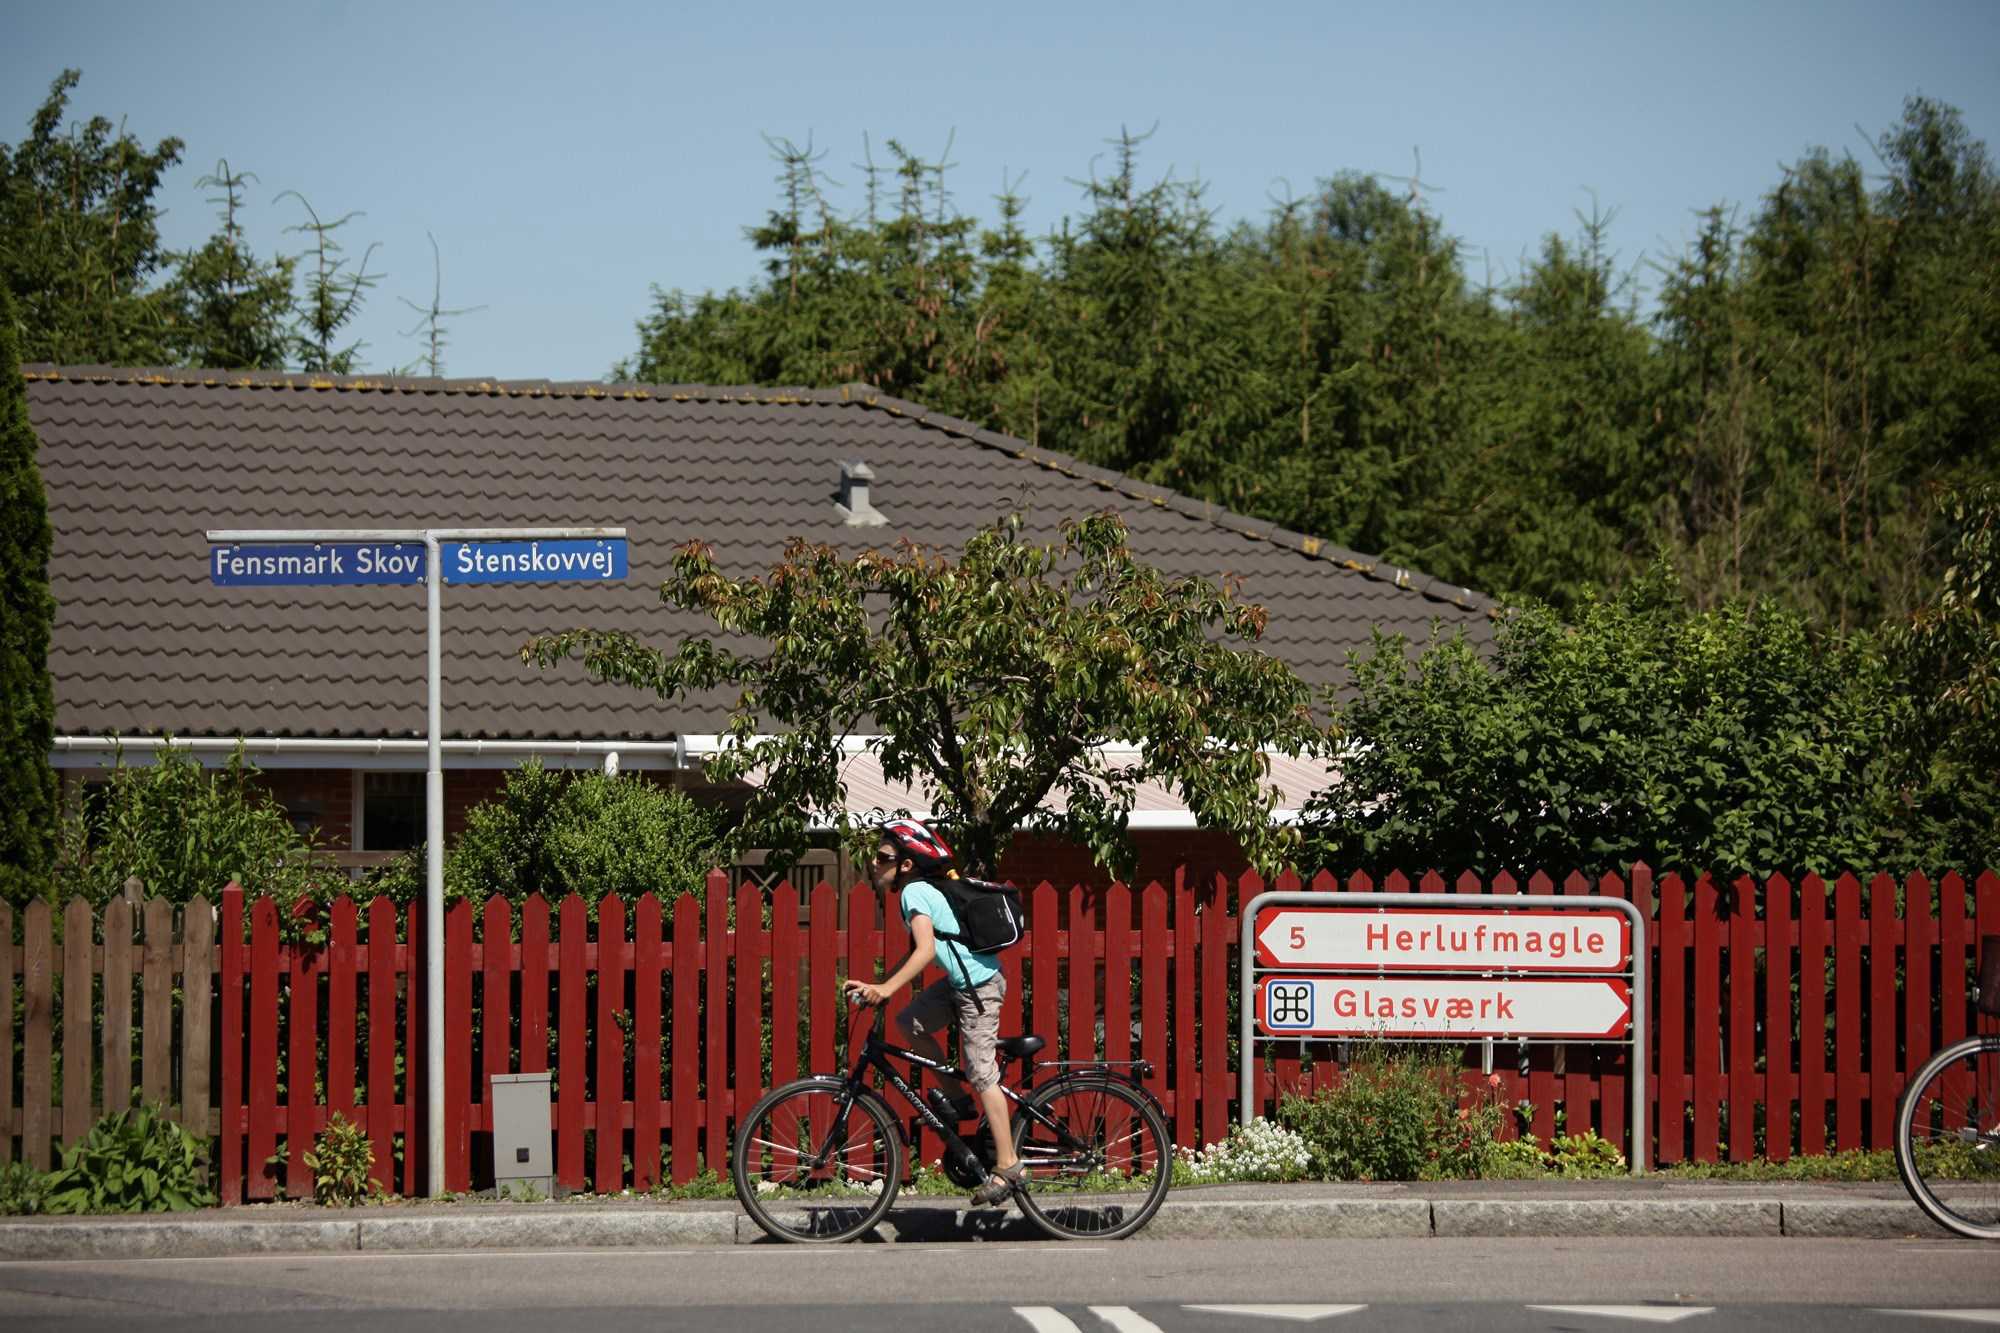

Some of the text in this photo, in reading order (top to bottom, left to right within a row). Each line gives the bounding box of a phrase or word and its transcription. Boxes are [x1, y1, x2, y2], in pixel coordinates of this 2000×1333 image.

[217, 547, 419, 576] Fensmark Skov
[457, 546, 613, 577] Stenskovvej
[1290, 923, 1605, 959] 5 Herlufmagle
[1334, 989, 1514, 1020] Glasværk
